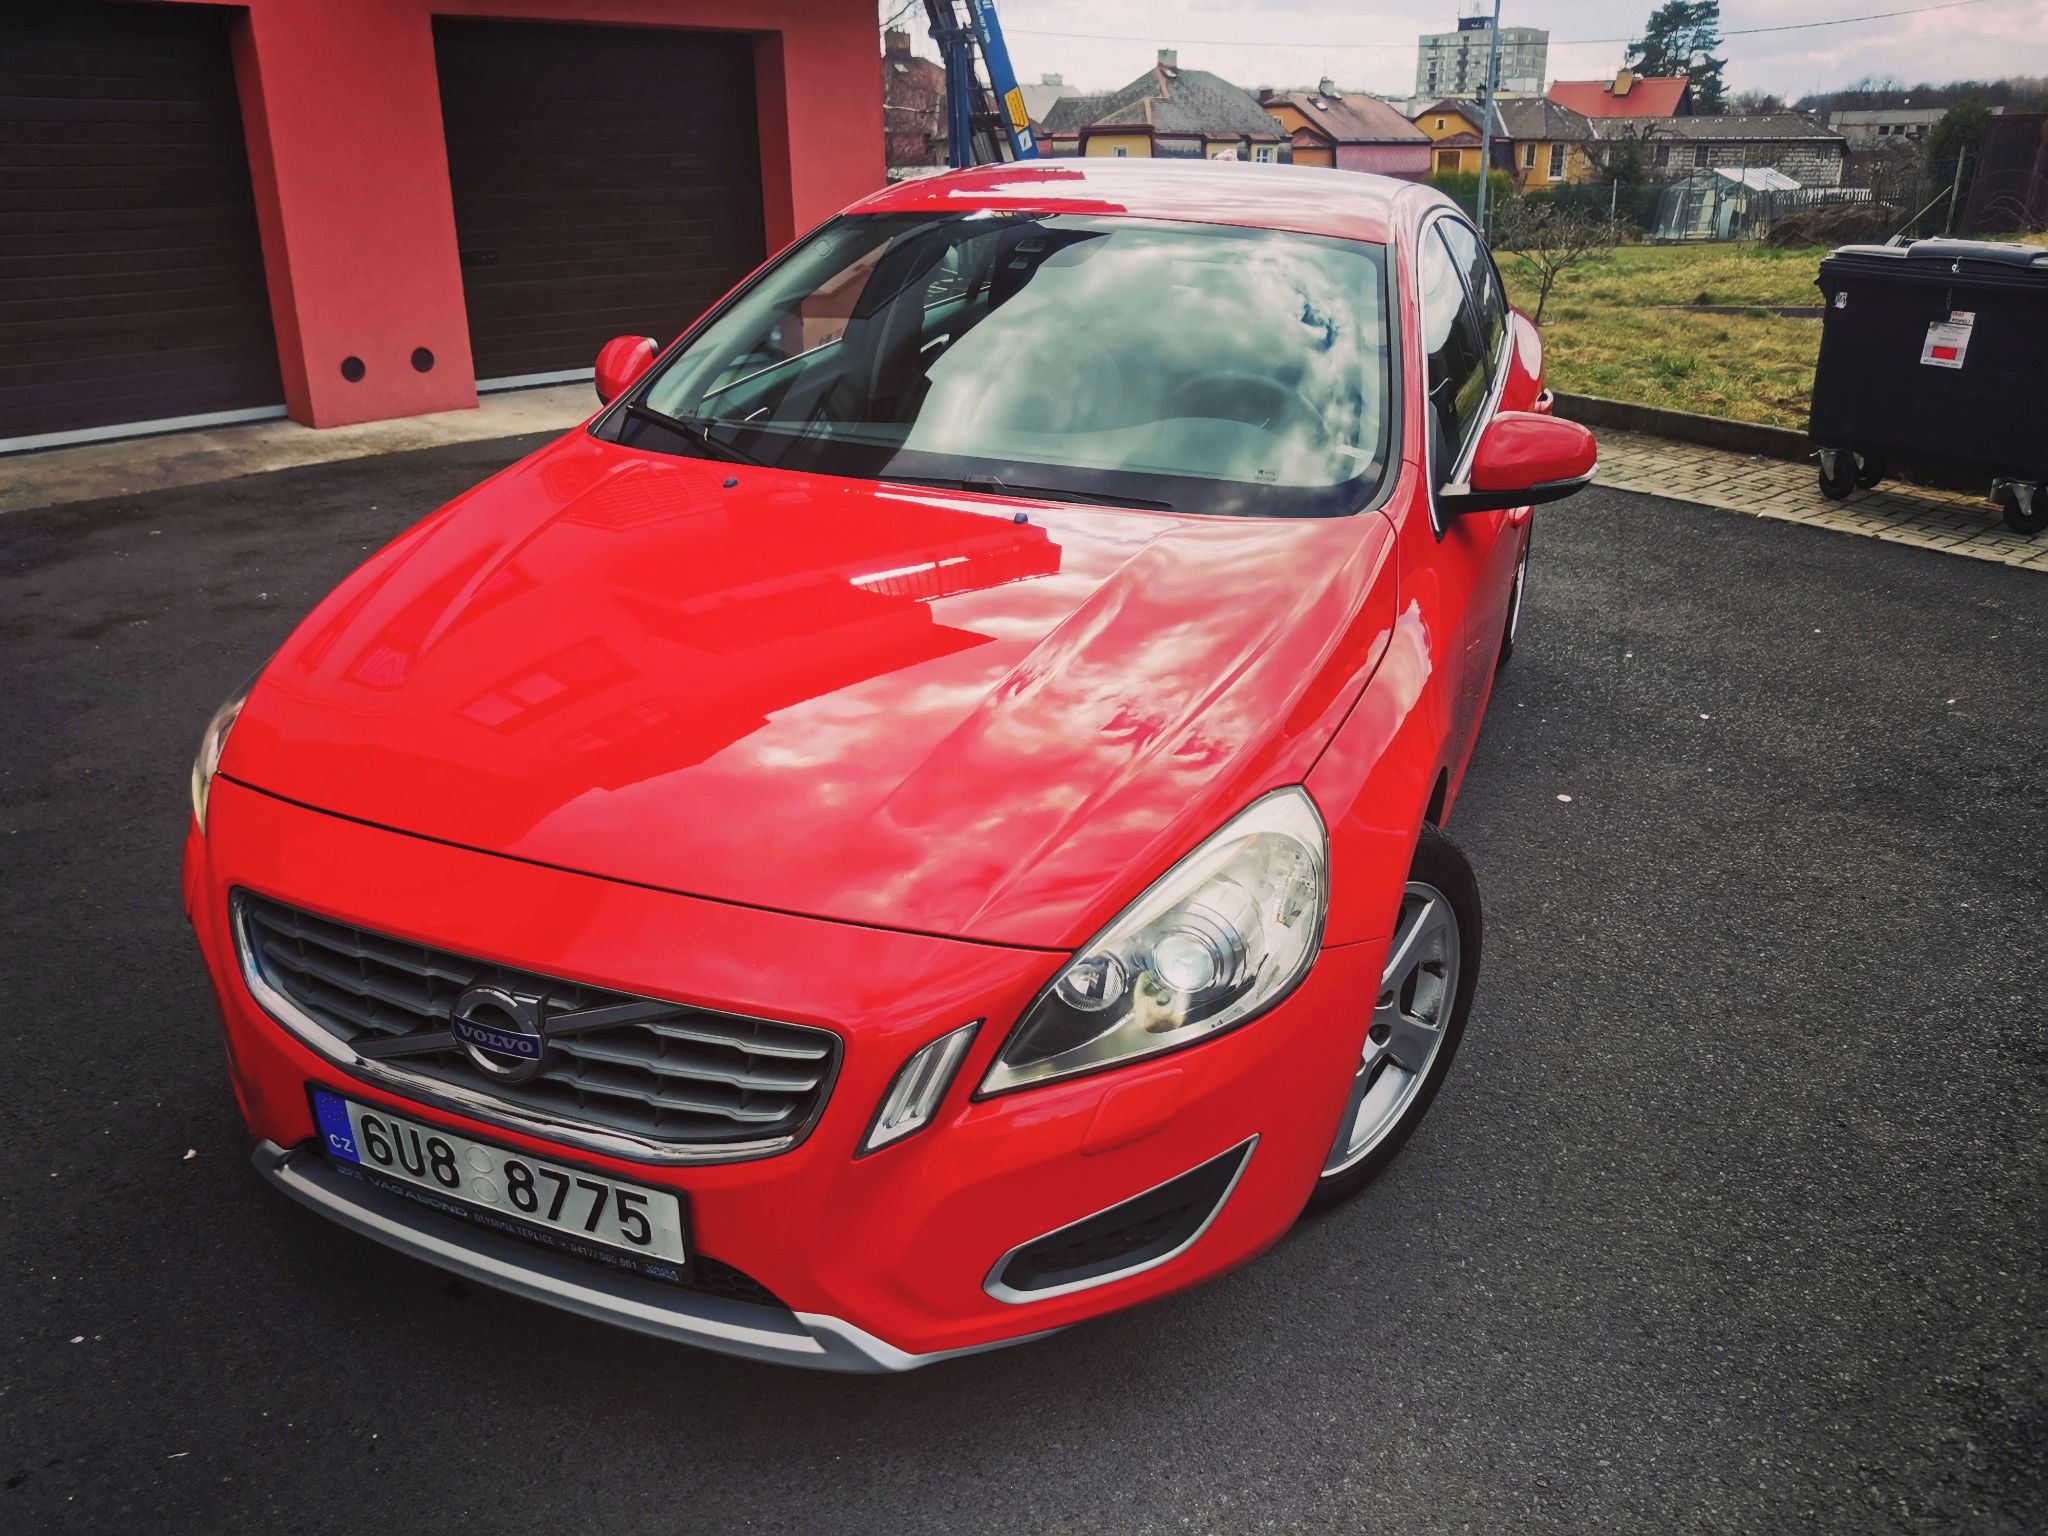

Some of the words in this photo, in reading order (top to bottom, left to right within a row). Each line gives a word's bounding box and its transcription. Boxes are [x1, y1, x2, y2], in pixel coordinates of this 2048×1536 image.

[457, 1022, 533, 1053] VOLVO
[330, 1133, 353, 1153] CZ
[360, 1114, 461, 1189] 6U8
[503, 1160, 652, 1246] 8775
[517, 1226, 554, 1246] TEPLICE
